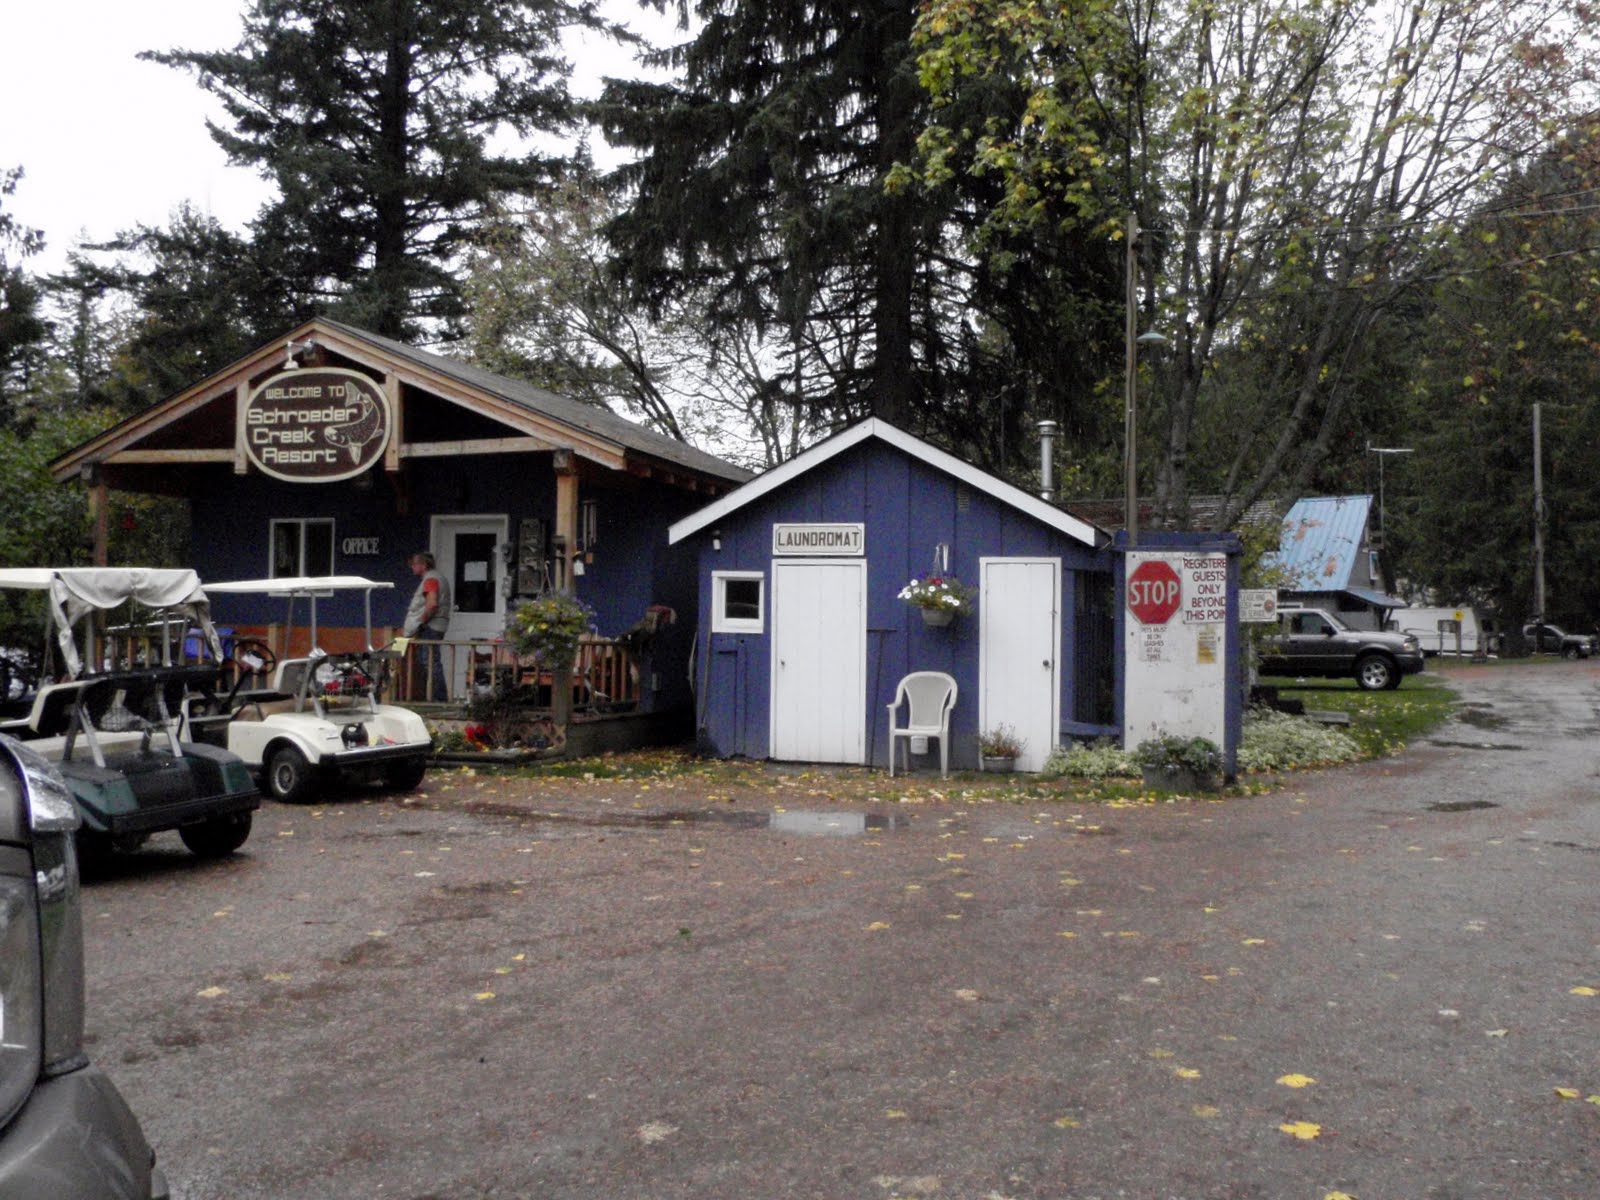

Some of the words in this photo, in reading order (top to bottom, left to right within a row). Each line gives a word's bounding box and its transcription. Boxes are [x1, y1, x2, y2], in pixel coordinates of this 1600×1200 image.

[248, 406, 358, 424] Schroeder
[253, 427, 316, 444] Creek
[262, 447, 337, 463] Resort
[342, 537, 380, 554] OFFICE
[778, 532, 860, 546] LAUNDROMAT
[1184, 558, 1226, 569] REGISTERE
[1192, 571, 1226, 581] GUESTS
[1130, 581, 1178, 605] STOP
[1197, 584, 1220, 594] ONLY
[1185, 610, 1205, 620] THIS
[1207, 609, 1226, 620] POIN
